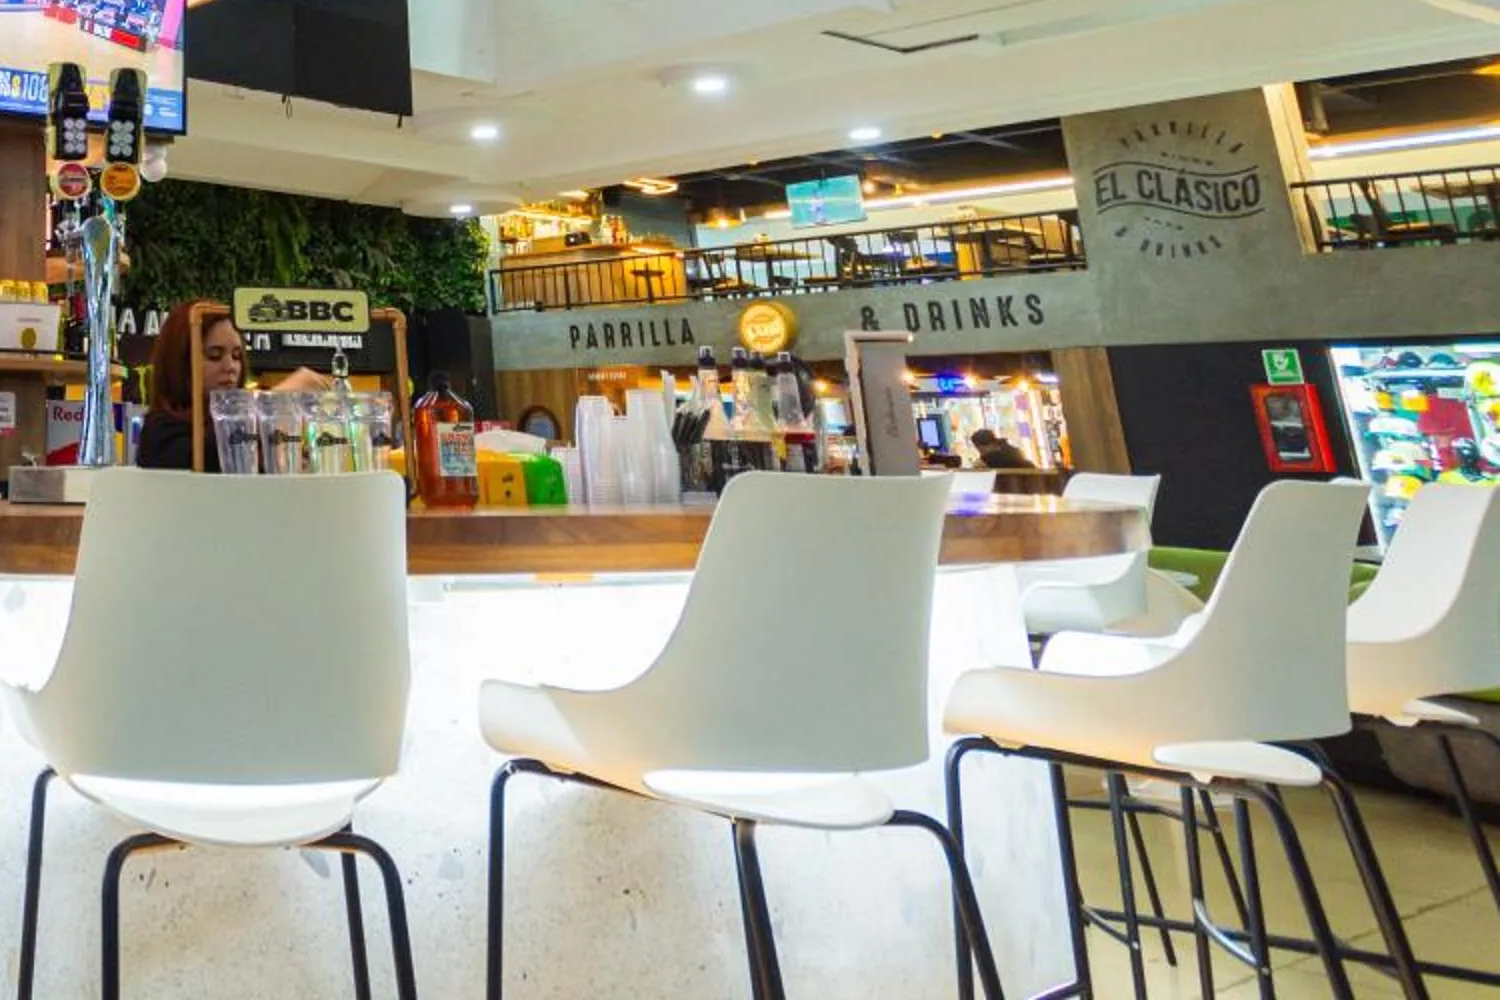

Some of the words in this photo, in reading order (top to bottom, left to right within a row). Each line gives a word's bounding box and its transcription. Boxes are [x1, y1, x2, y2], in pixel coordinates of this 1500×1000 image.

[1094, 170, 1127, 207] EL
[1136, 167, 1262, 214] CLÁSICO
[285, 300, 355, 324] BBC
[860, 304, 880, 332] &
[903, 293, 1046, 333] DRINKS
[569, 317, 696, 350] PARRILLA
